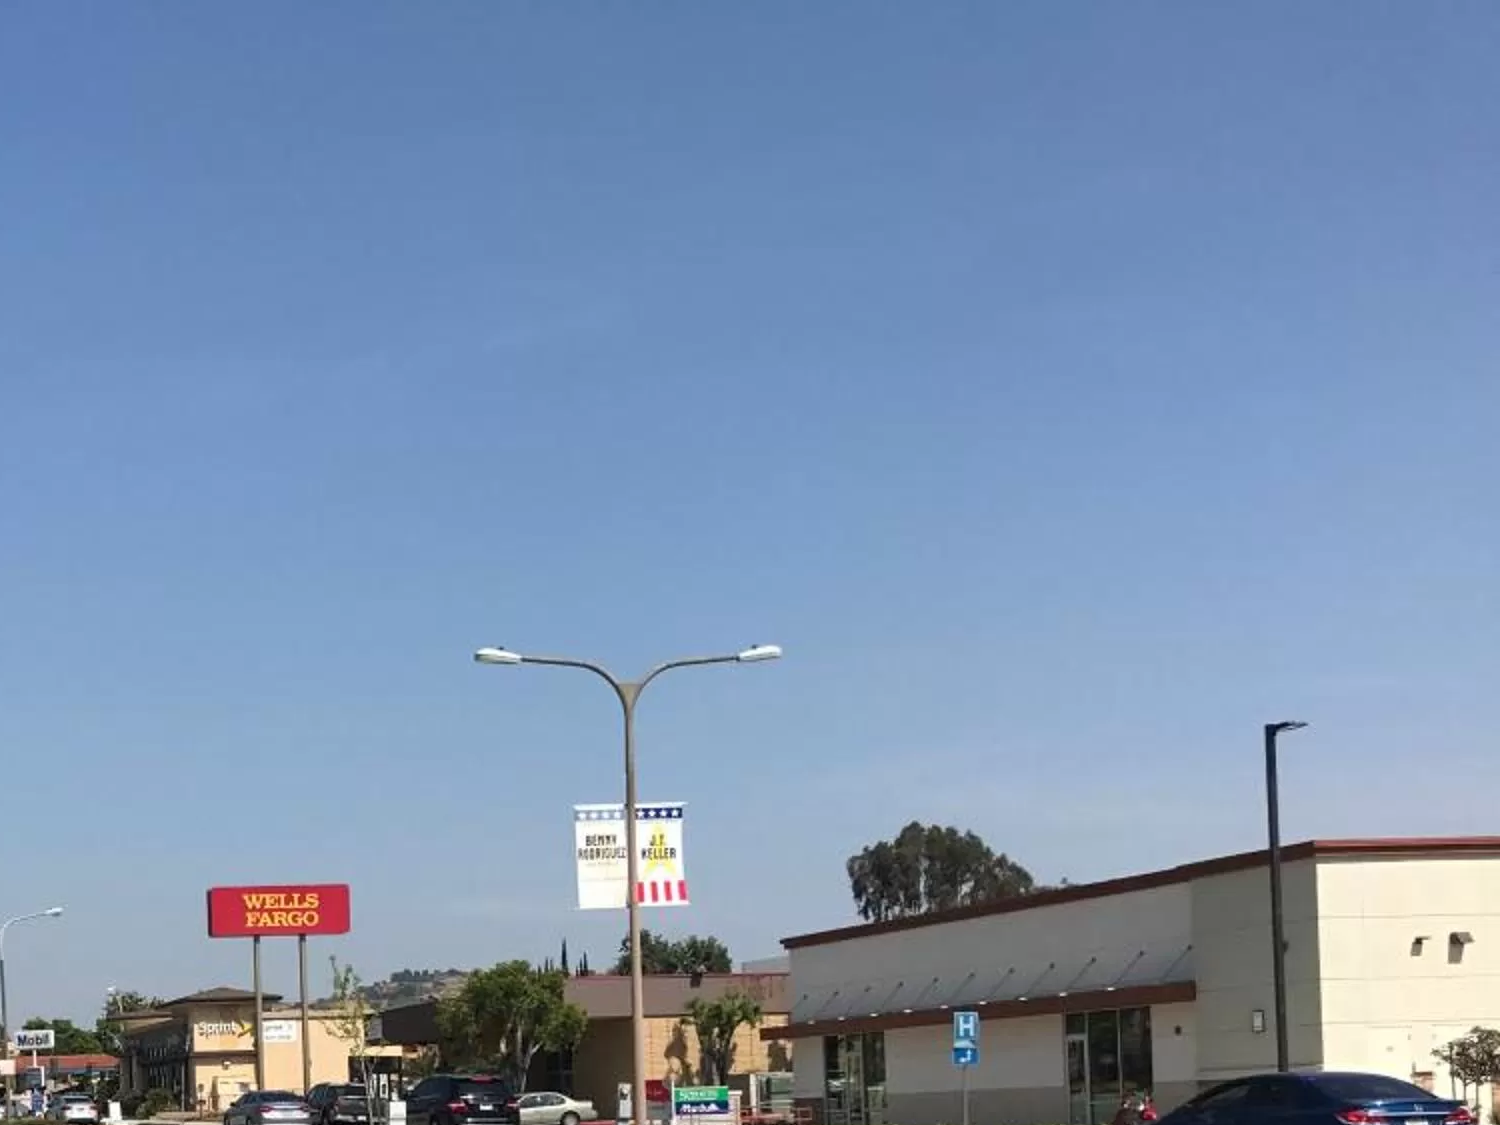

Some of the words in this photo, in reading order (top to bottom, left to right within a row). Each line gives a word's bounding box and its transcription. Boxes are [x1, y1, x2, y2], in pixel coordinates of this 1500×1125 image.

[641, 848, 677, 860] KELLER
[242, 893, 319, 909] WELLS
[245, 911, 319, 927] FARGO
[198, 1020, 236, 1035] Sprint
[959, 1015, 975, 1037] H
[17, 1033, 50, 1046] Mobil
